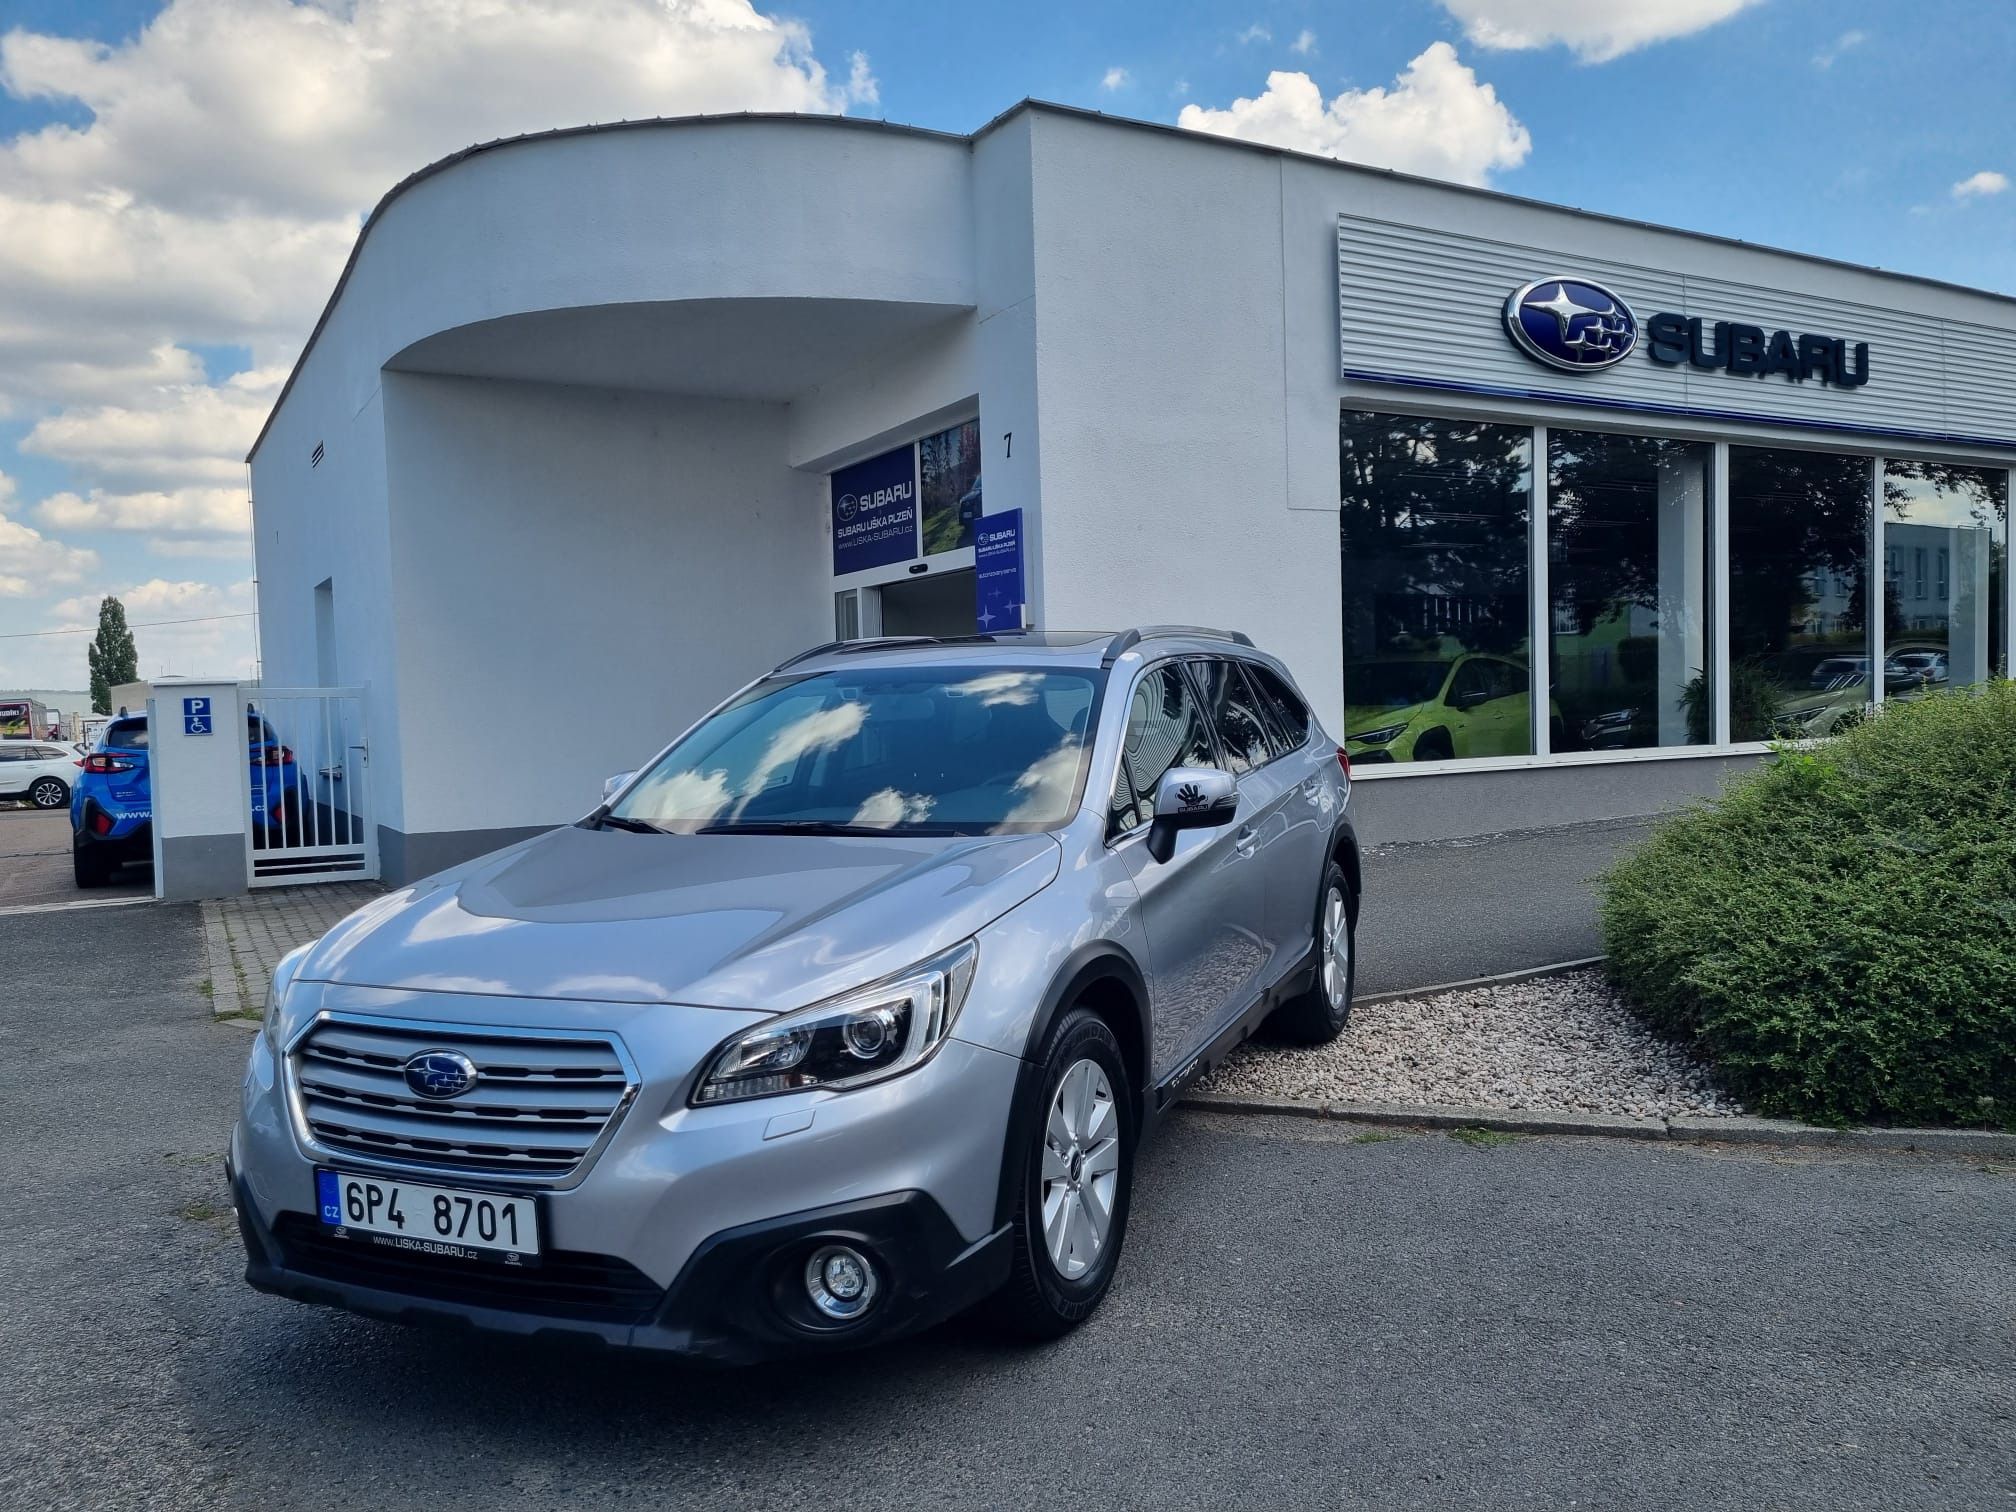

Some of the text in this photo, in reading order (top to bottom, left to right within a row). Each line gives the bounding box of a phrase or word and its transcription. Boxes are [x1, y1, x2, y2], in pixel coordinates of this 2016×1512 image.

[1646, 311, 1870, 387] SUBARU
[1003, 431, 1013, 459] 7
[859, 480, 913, 512] SUBARU
[837, 521, 867, 539] SUBARU
[887, 506, 913, 525] PLZEŇ
[989, 528, 1016, 542] SUBARU
[191, 699, 205, 714] P
[324, 1204, 340, 1219] CZ
[346, 1181, 519, 1246] 6P4 8701
